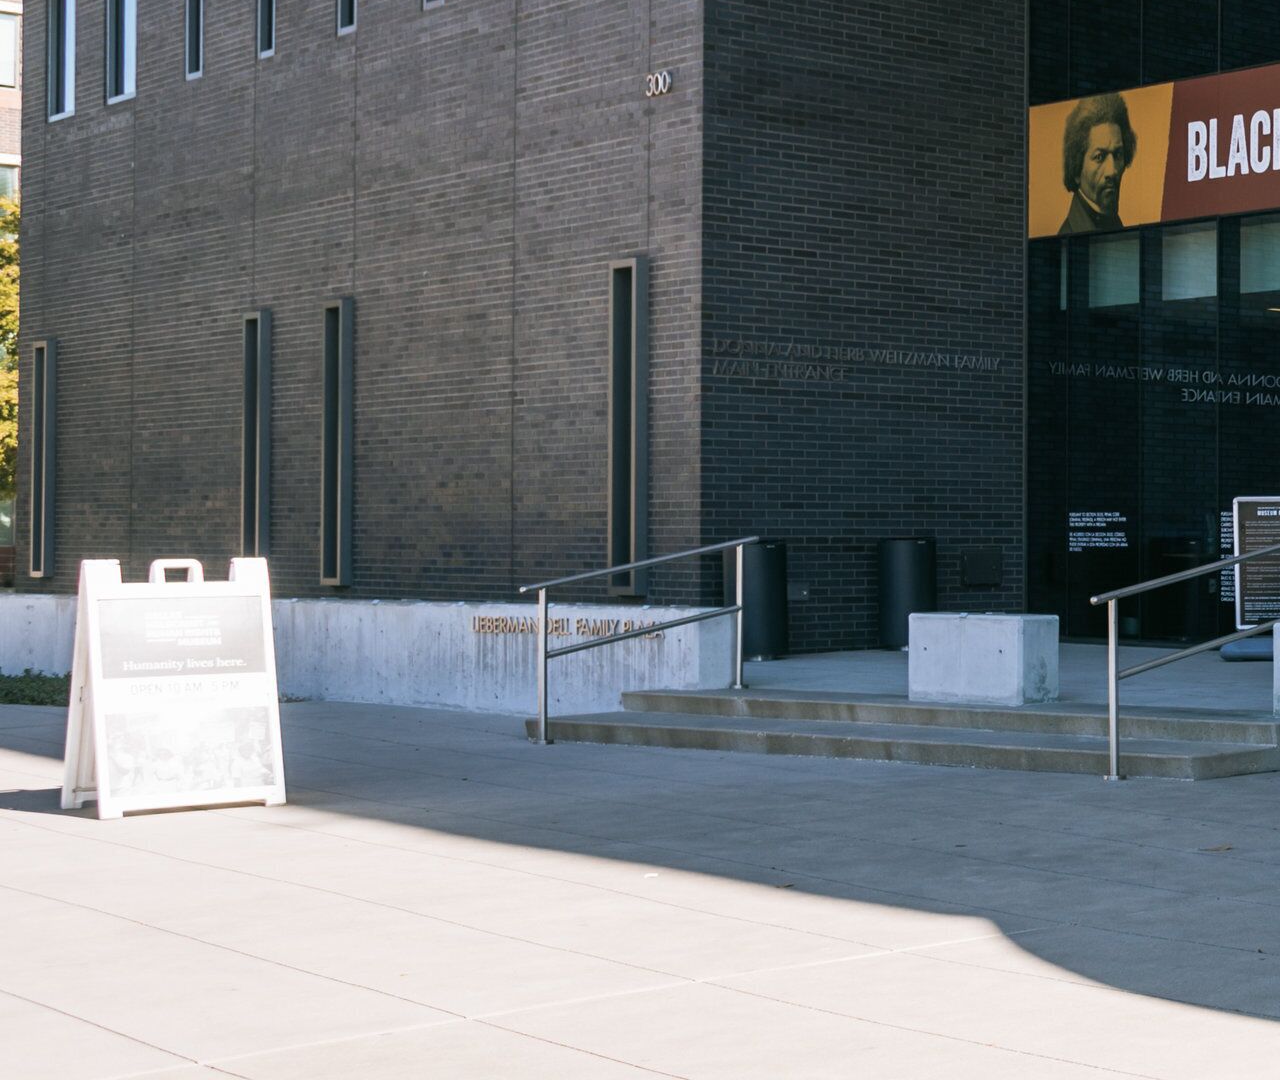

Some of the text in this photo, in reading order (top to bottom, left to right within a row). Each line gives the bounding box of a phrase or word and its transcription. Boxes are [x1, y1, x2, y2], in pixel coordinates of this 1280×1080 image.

[645, 71, 672, 97] 300
[869, 348, 950, 367] WEITZMAN
[954, 354, 1001, 371] FAMILY
[473, 616, 541, 635] LIEBERMAN
[576, 617, 620, 636] FAMILY
[123, 657, 247, 671] Humanity lives here.
